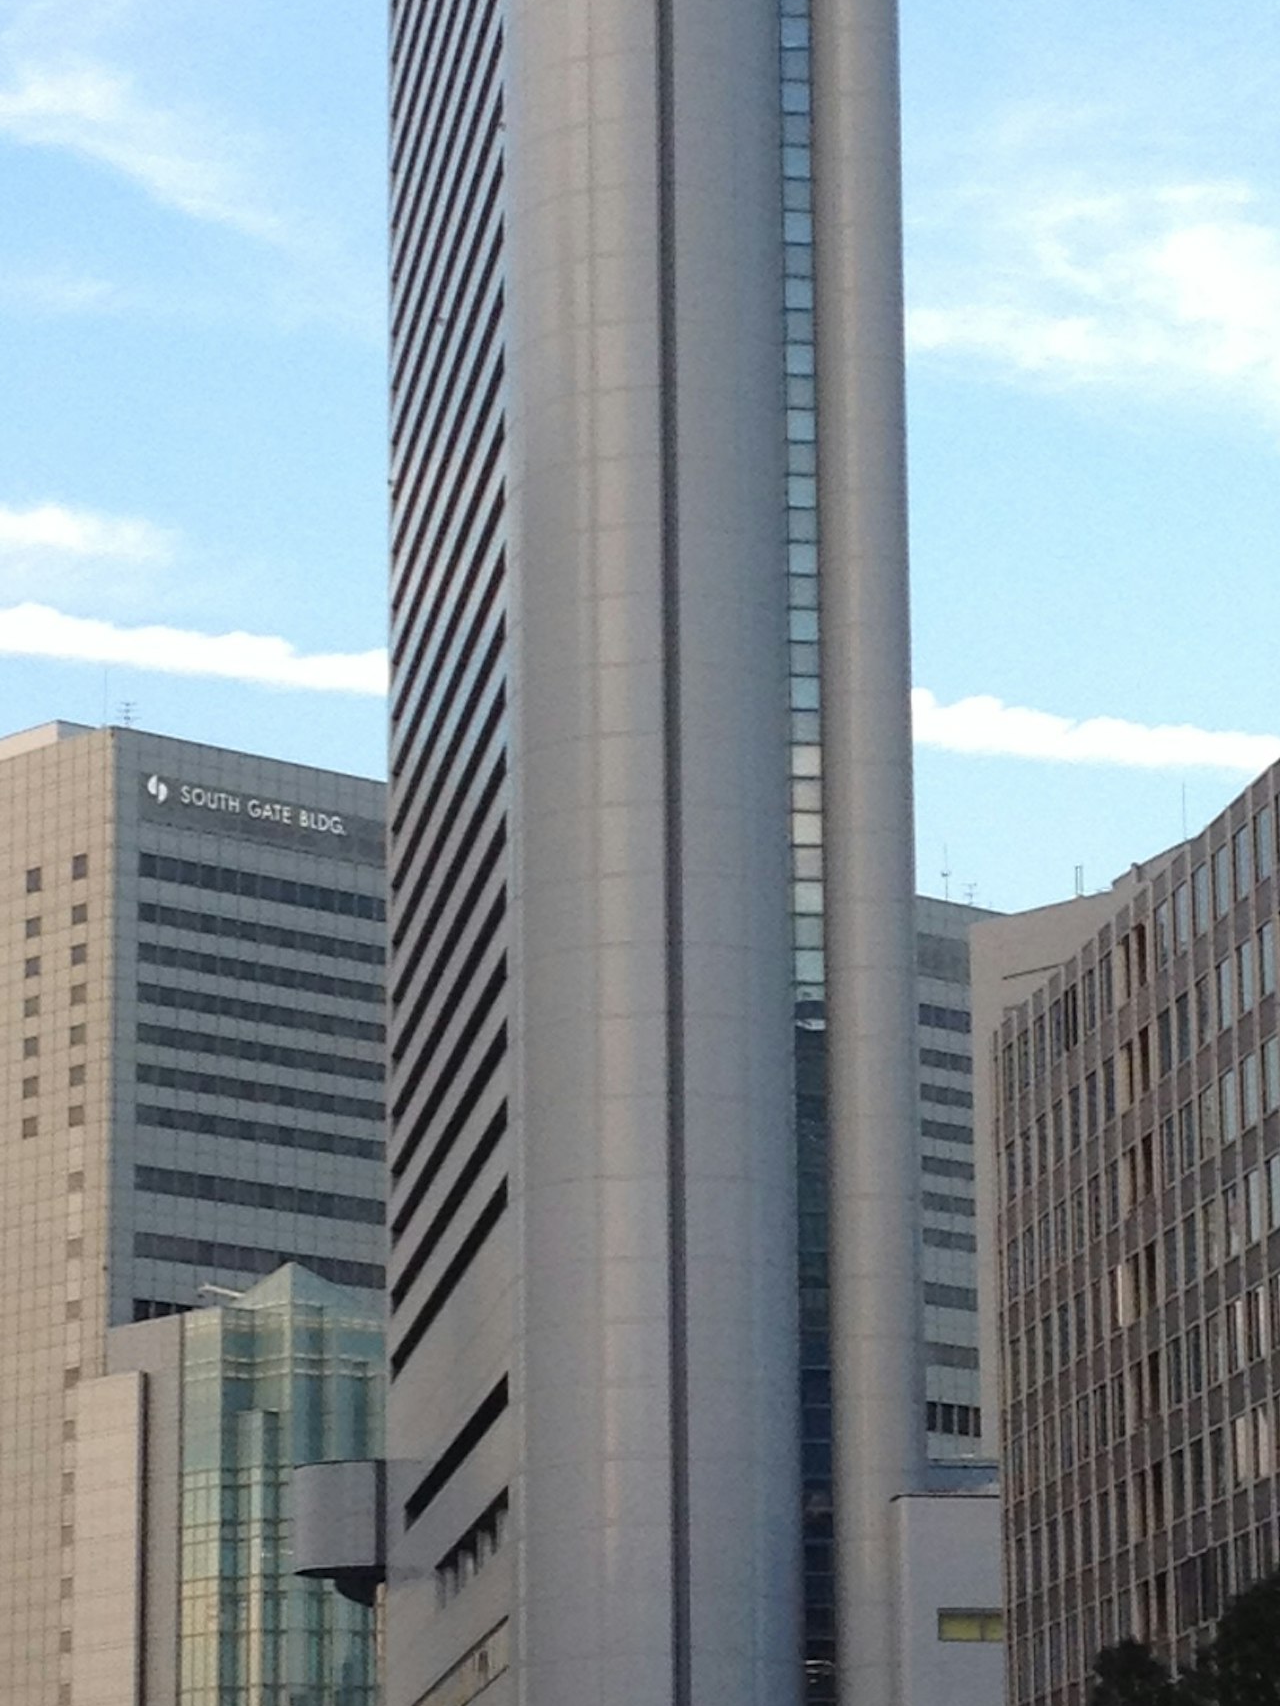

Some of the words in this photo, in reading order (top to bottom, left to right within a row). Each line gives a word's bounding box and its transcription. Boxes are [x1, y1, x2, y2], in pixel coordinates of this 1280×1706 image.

[180, 785, 240, 814] SOUTH
[246, 799, 292, 825] GATE
[298, 809, 348, 836] BLDG.
